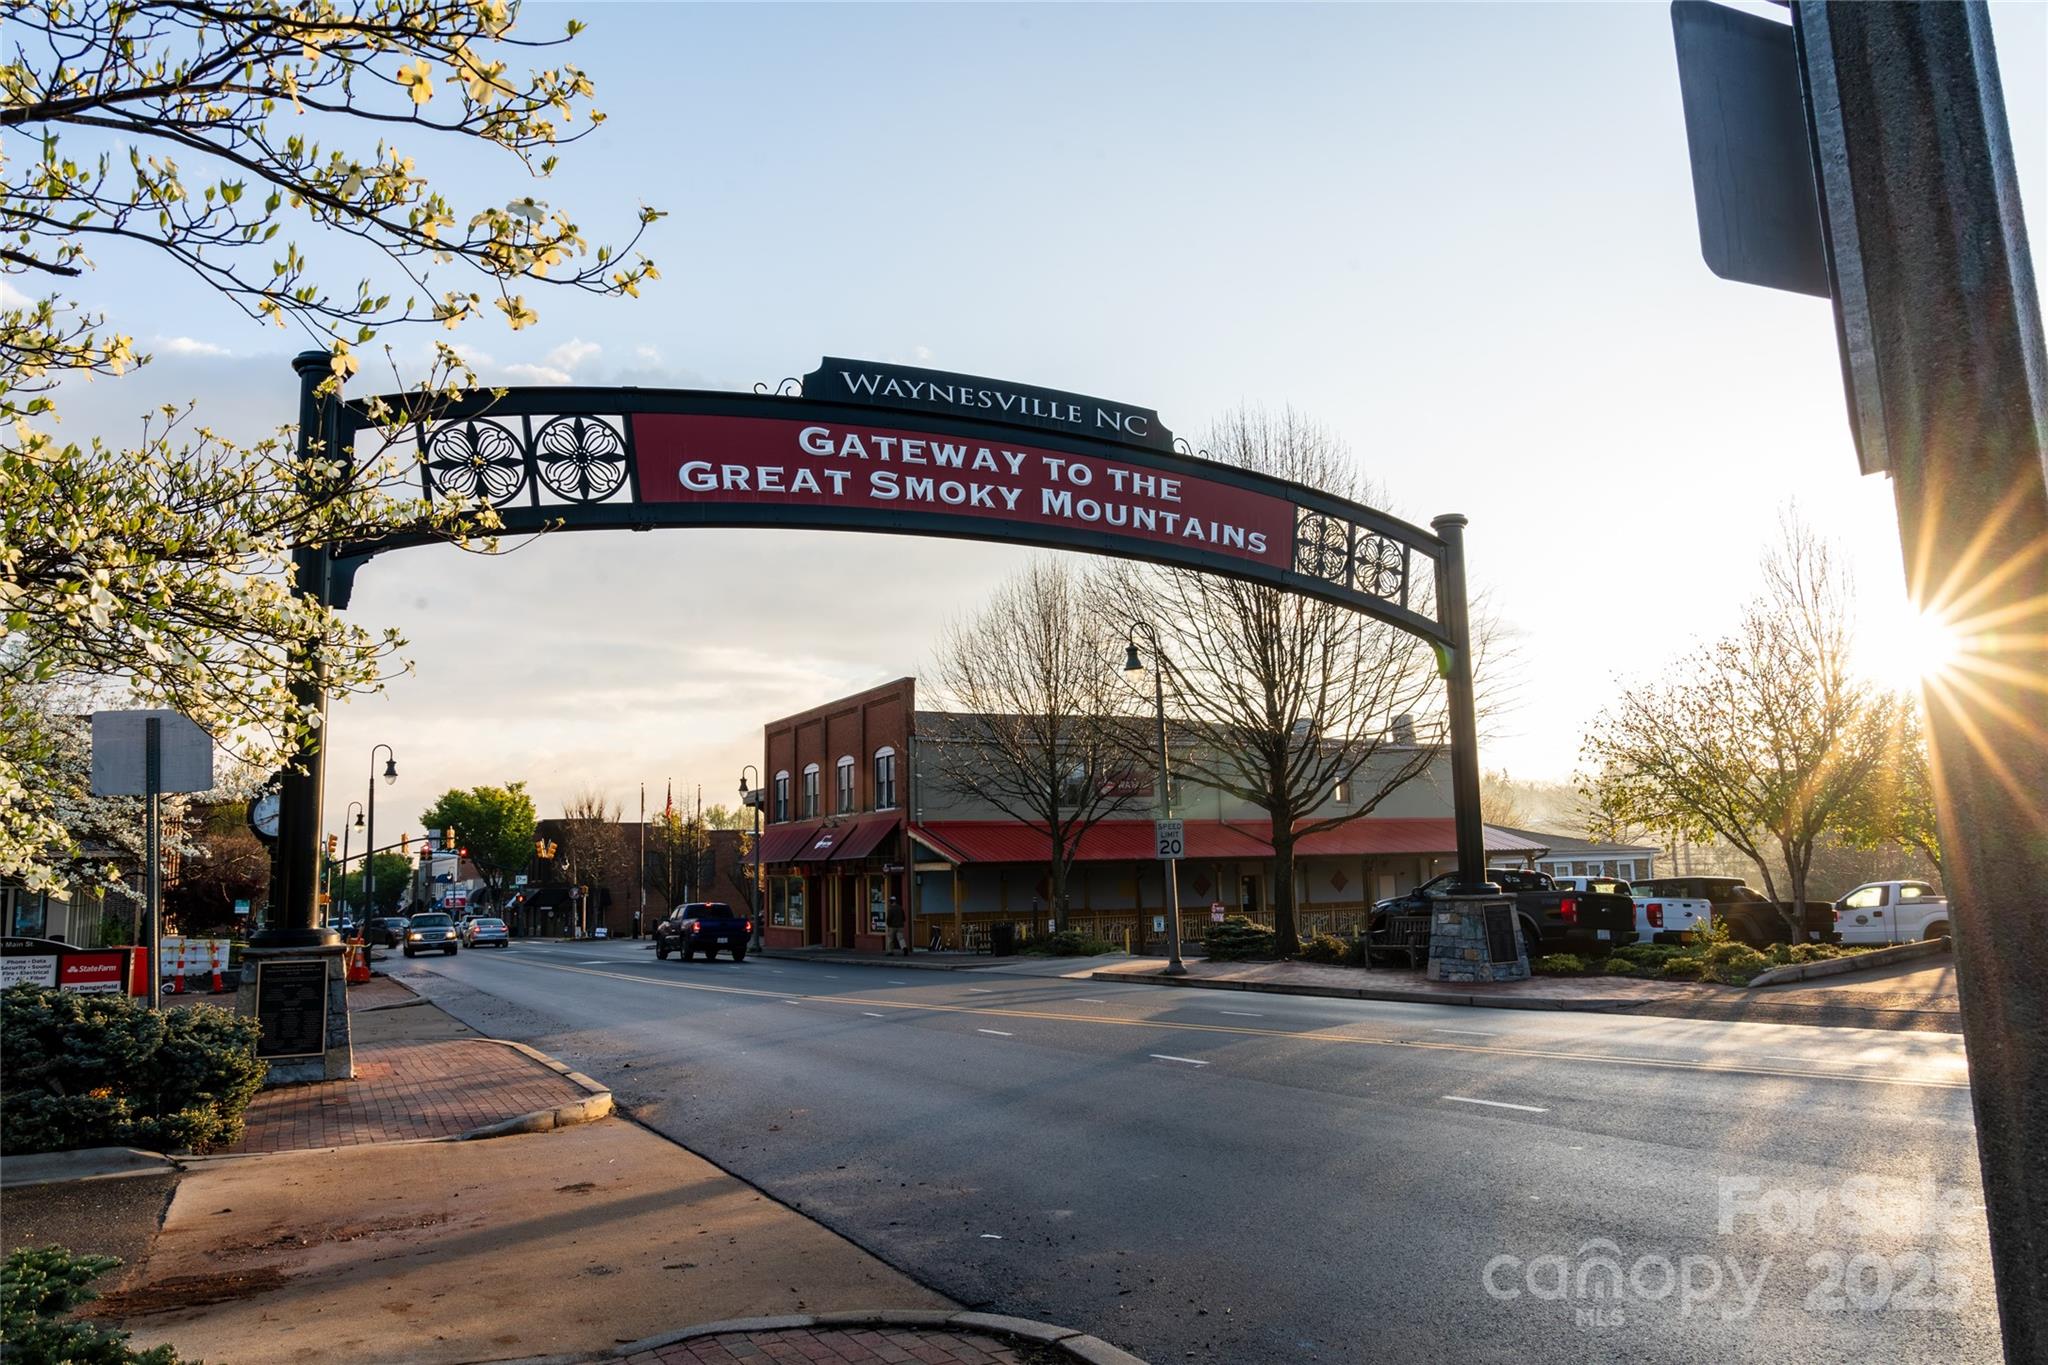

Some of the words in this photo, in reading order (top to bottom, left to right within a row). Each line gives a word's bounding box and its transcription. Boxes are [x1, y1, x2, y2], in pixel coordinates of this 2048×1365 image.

[839, 370, 1082, 425] WAYNESVILLE
[1095, 408, 1148, 437] NC
[798, 426, 1027, 475] GATEWAY
[1042, 456, 1093, 487] TO
[1107, 468, 1182, 503] THE
[678, 460, 851, 496] GREAT
[870, 471, 1023, 511] SMOKY
[1041, 488, 1268, 555] MOUNTAINS
[1160, 840, 1181, 854] 20
